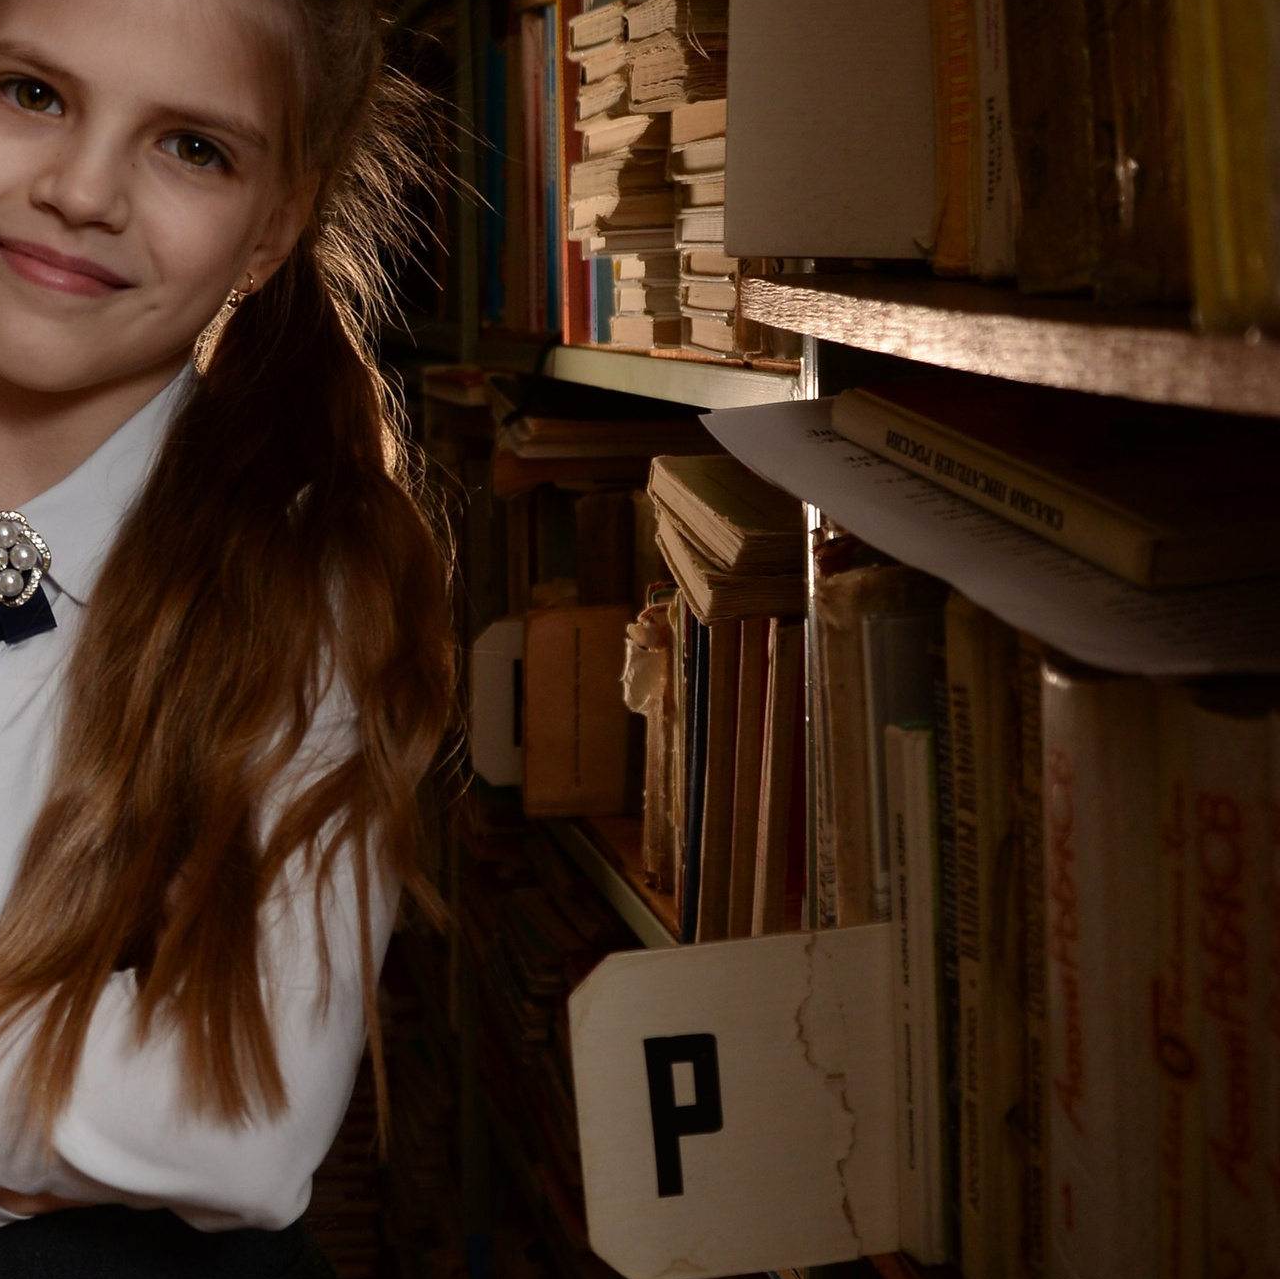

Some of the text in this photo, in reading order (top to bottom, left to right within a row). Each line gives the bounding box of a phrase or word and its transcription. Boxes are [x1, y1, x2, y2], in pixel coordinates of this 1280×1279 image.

[885, 429, 1064, 532] СКАЗКИ ПИСАТЕЛЕЙ РОССИИ
[896, 813, 905, 866] ОЗЕРО
[643, 1032, 724, 1199] Р
